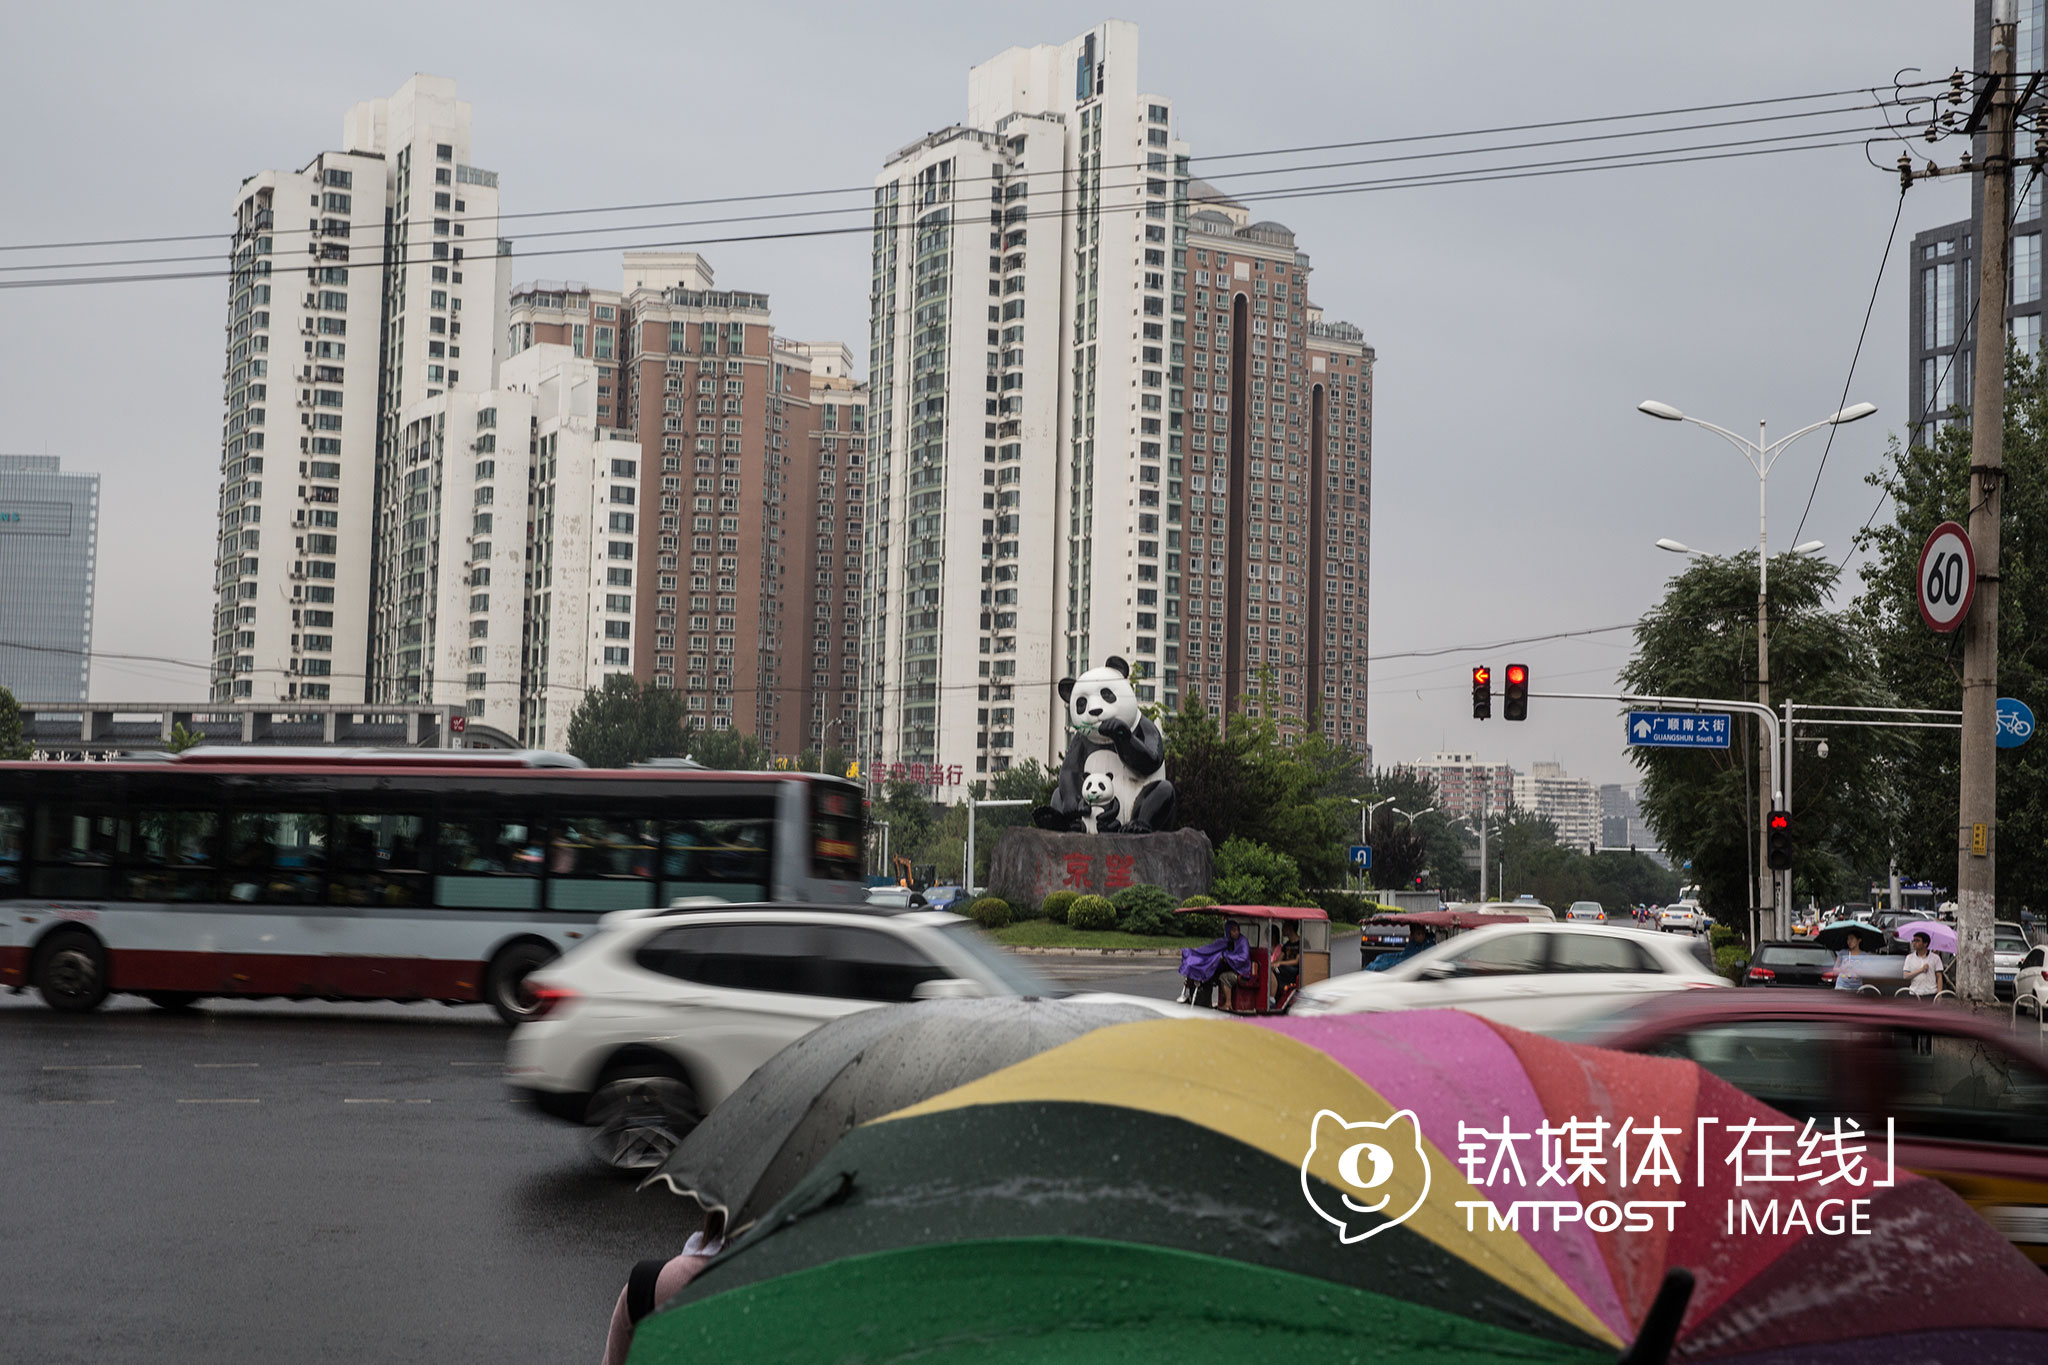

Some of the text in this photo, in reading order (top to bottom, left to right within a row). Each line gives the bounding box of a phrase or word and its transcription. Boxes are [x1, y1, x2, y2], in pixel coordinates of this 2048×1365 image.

[1927, 552, 1963, 606] 60
[1653, 717, 1725, 733] 广顺南大街
[1653, 733, 1723, 743] GUANGSHUN South St
